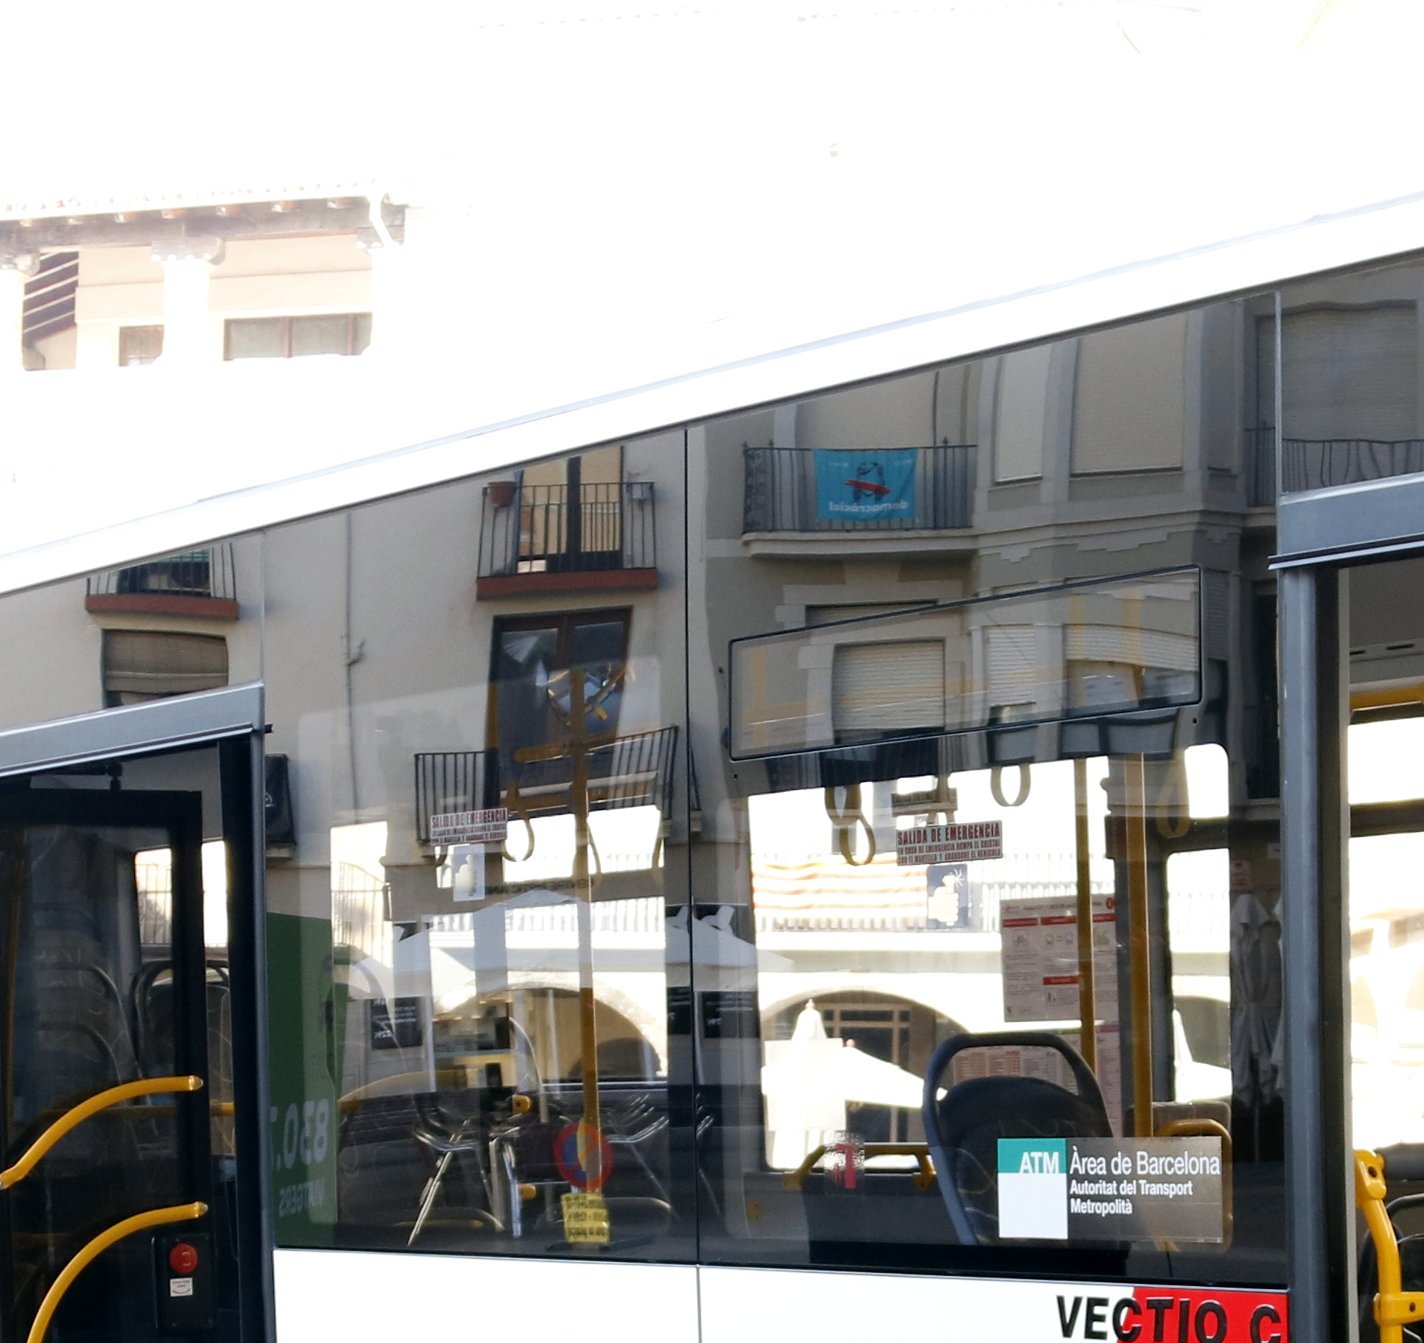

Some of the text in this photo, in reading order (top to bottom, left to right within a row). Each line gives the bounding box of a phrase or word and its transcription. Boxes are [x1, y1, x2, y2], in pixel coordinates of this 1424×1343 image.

[898, 822, 1000, 845] SALIDA DE EMERGENCIA
[1019, 1145, 1221, 1175] ATM Àrea de Barcelona
[1070, 1179, 1193, 1198] Autoritat del Transport
[1070, 1198, 1133, 1217] Metropolità
